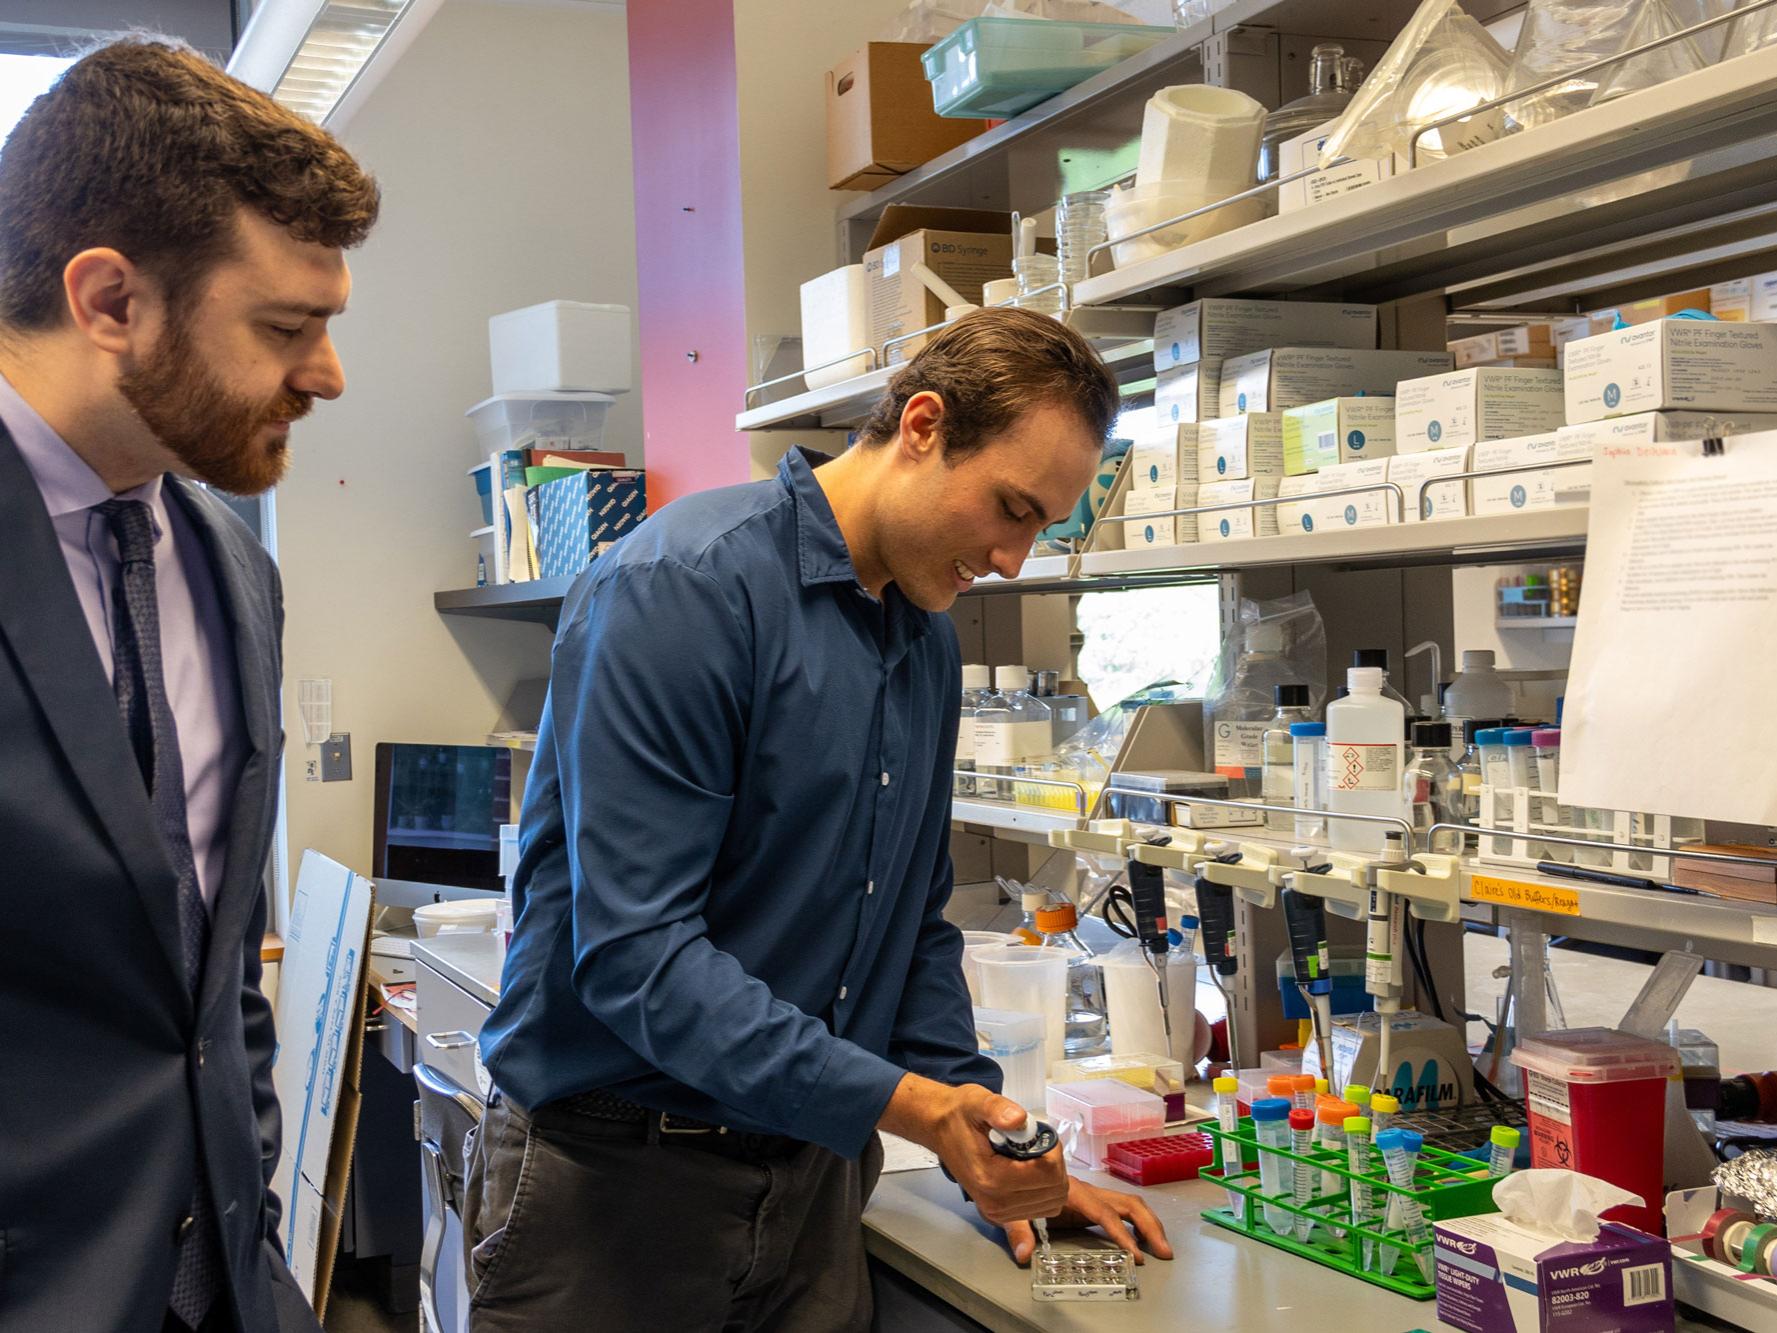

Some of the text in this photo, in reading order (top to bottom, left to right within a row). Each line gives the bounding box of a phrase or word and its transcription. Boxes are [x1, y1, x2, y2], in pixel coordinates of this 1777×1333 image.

[942, 243, 988, 256] BD Syringe
[1693, 328, 1702, 337] PF
[1705, 328, 1726, 340] Finger
[1728, 330, 1759, 340] Textured
[1670, 338, 1764, 350] Nitrile Examination Gloves
[1606, 388, 1617, 402] M
[1508, 888, 1521, 900] Old
[1436, 1233, 1456, 1249] VWR
[1450, 1268, 1480, 1286] LIGHT-DUTY
[1550, 1266, 1580, 1281] VWR
[1452, 1277, 1472, 1291] WIPERS
[1552, 1291, 1590, 1304] 82003-820
